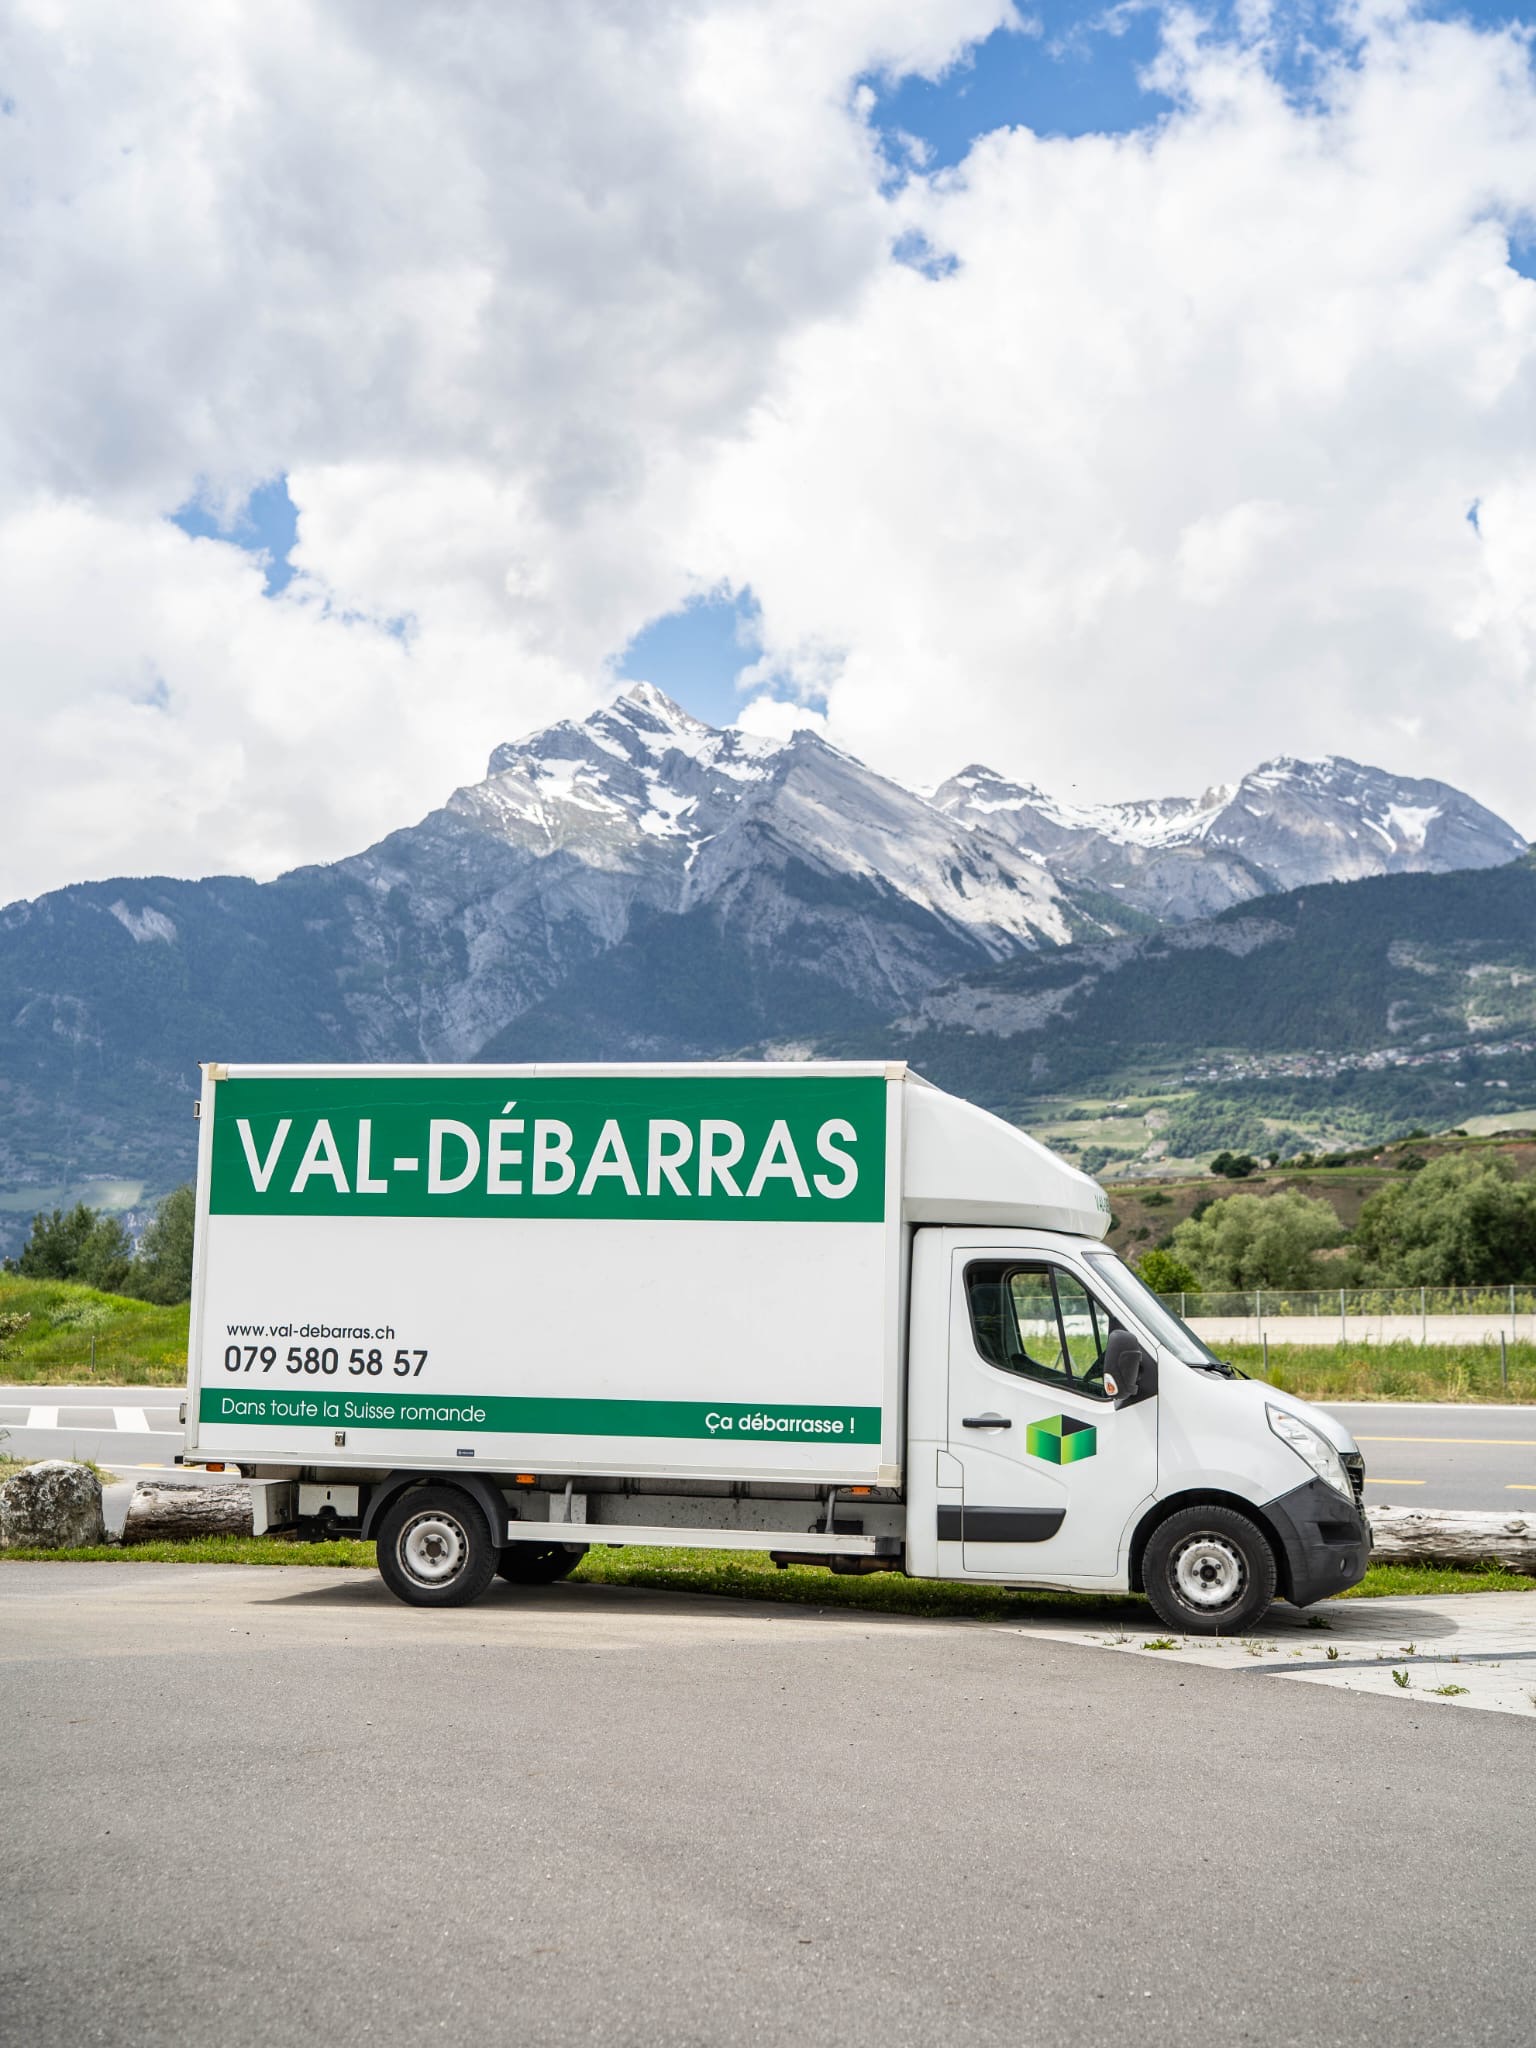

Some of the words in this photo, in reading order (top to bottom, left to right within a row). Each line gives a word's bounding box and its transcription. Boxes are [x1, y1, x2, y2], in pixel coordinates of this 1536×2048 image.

[237, 1102, 858, 1199] VAL-DÉBARRAS
[227, 1324, 395, 1339] www.val-debarras.ch
[225, 1346, 276, 1372] 079
[286, 1347, 338, 1374] 580
[348, 1349, 383, 1375] 58
[393, 1350, 427, 1376] 57
[222, 1398, 265, 1415] Dans
[271, 1400, 317, 1416] toute
[324, 1402, 339, 1417] la
[344, 1402, 395, 1419] Suisse
[401, 1406, 486, 1422] romande
[705, 1413, 732, 1433] Ça
[739, 1413, 844, 1432] débarrasse
[850, 1418, 855, 1433] !
